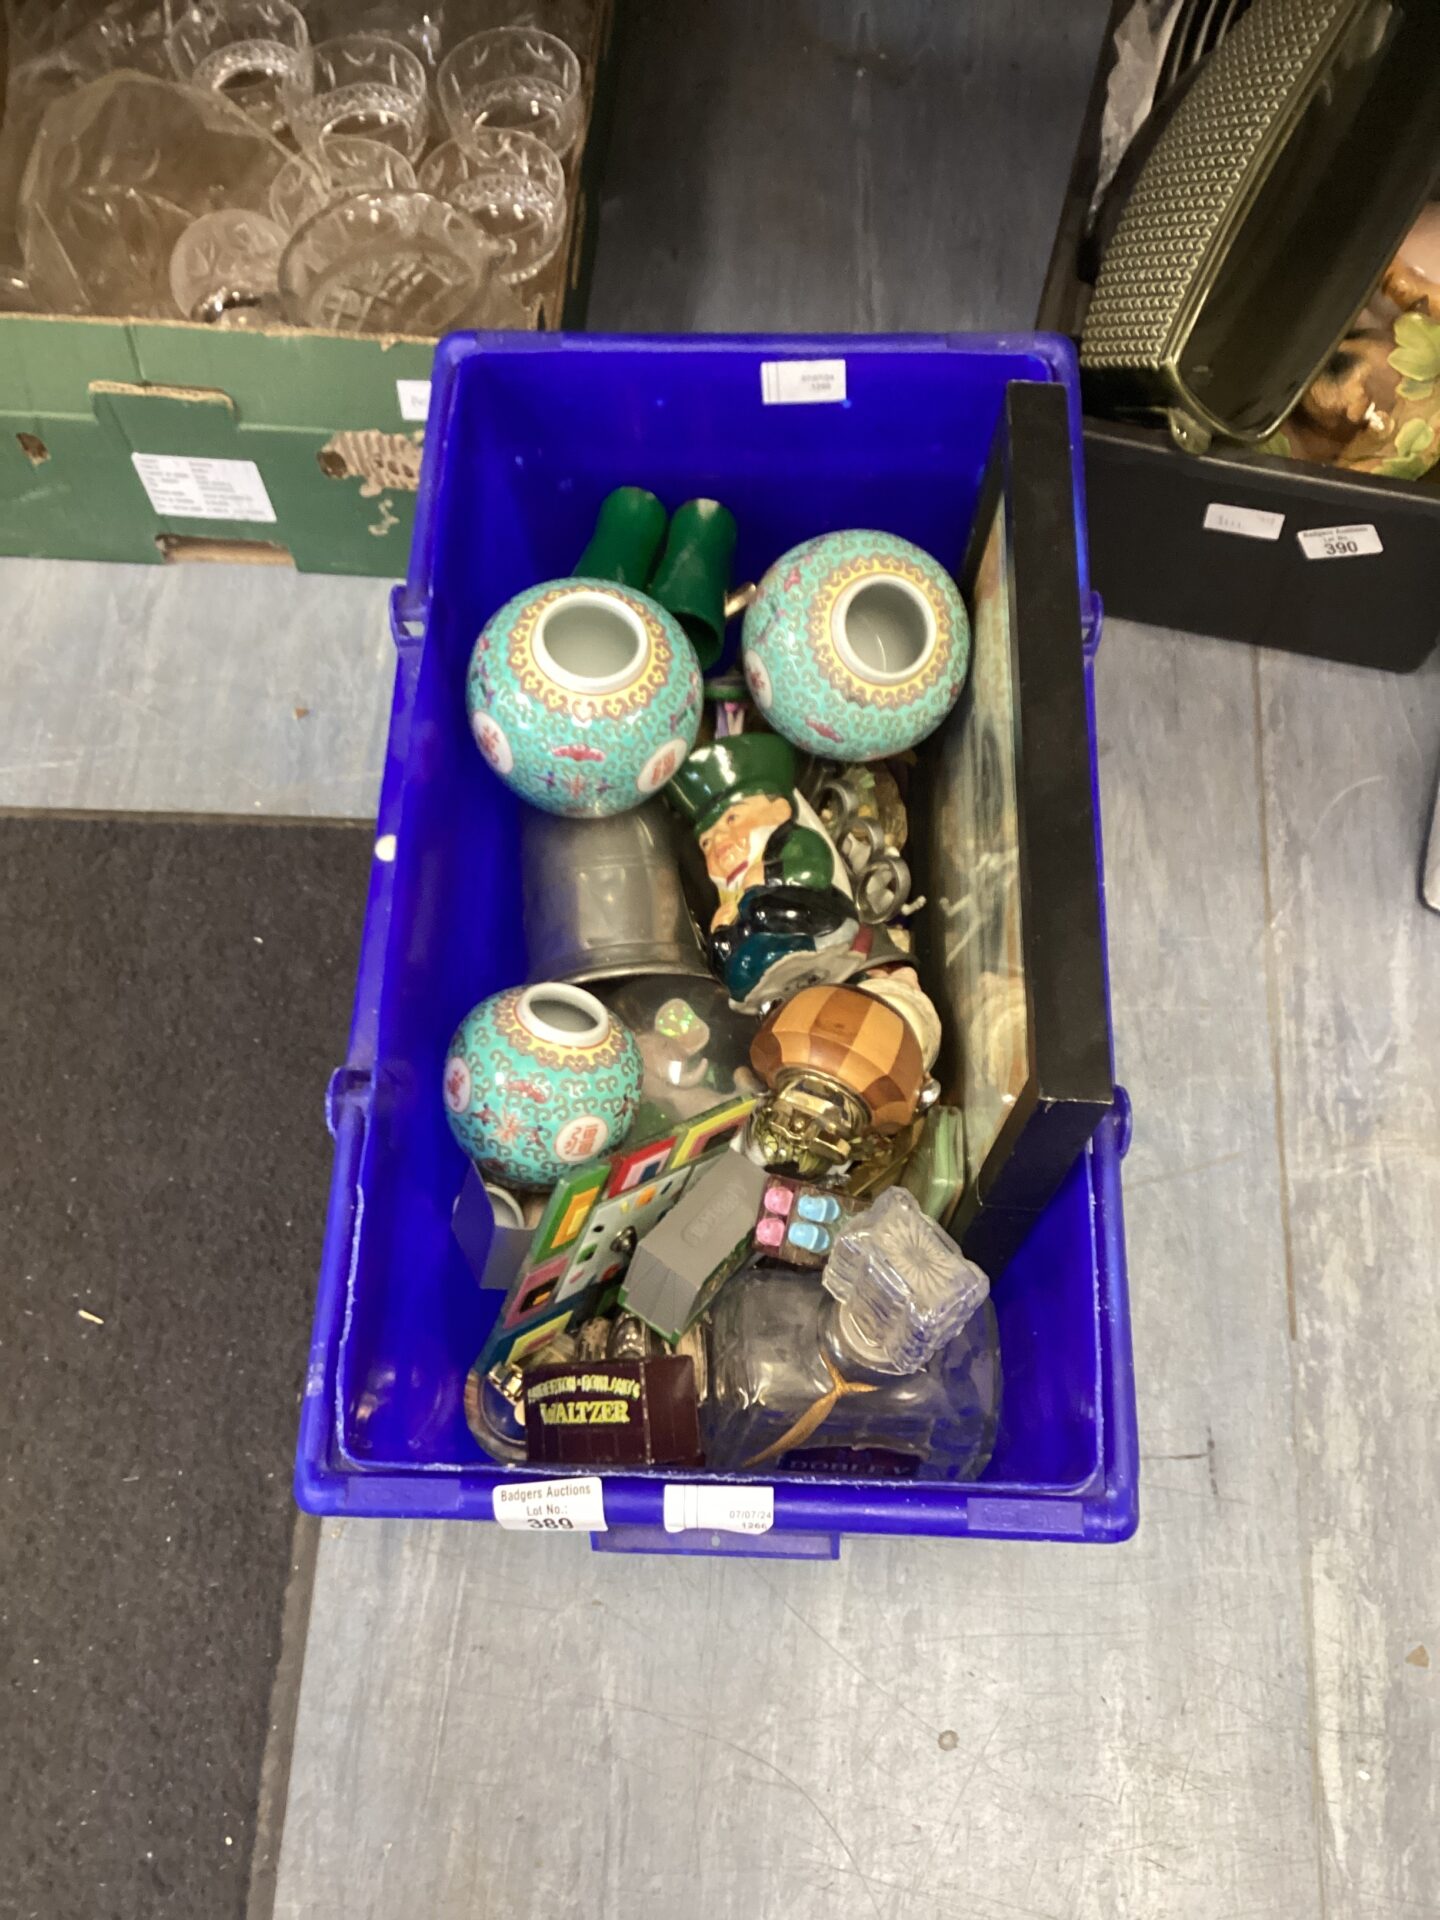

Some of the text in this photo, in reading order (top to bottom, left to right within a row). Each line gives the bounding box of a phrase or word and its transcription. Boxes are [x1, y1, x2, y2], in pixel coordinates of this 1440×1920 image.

[1324, 541, 1358, 555] 390
[539, 1400, 631, 1425] WALTZER
[500, 1484, 591, 1502] Badgers Auctions
[526, 1505, 542, 1517] Lot
[729, 1510, 772, 1519] 07/07/24
[527, 1517, 574, 1529] 389
